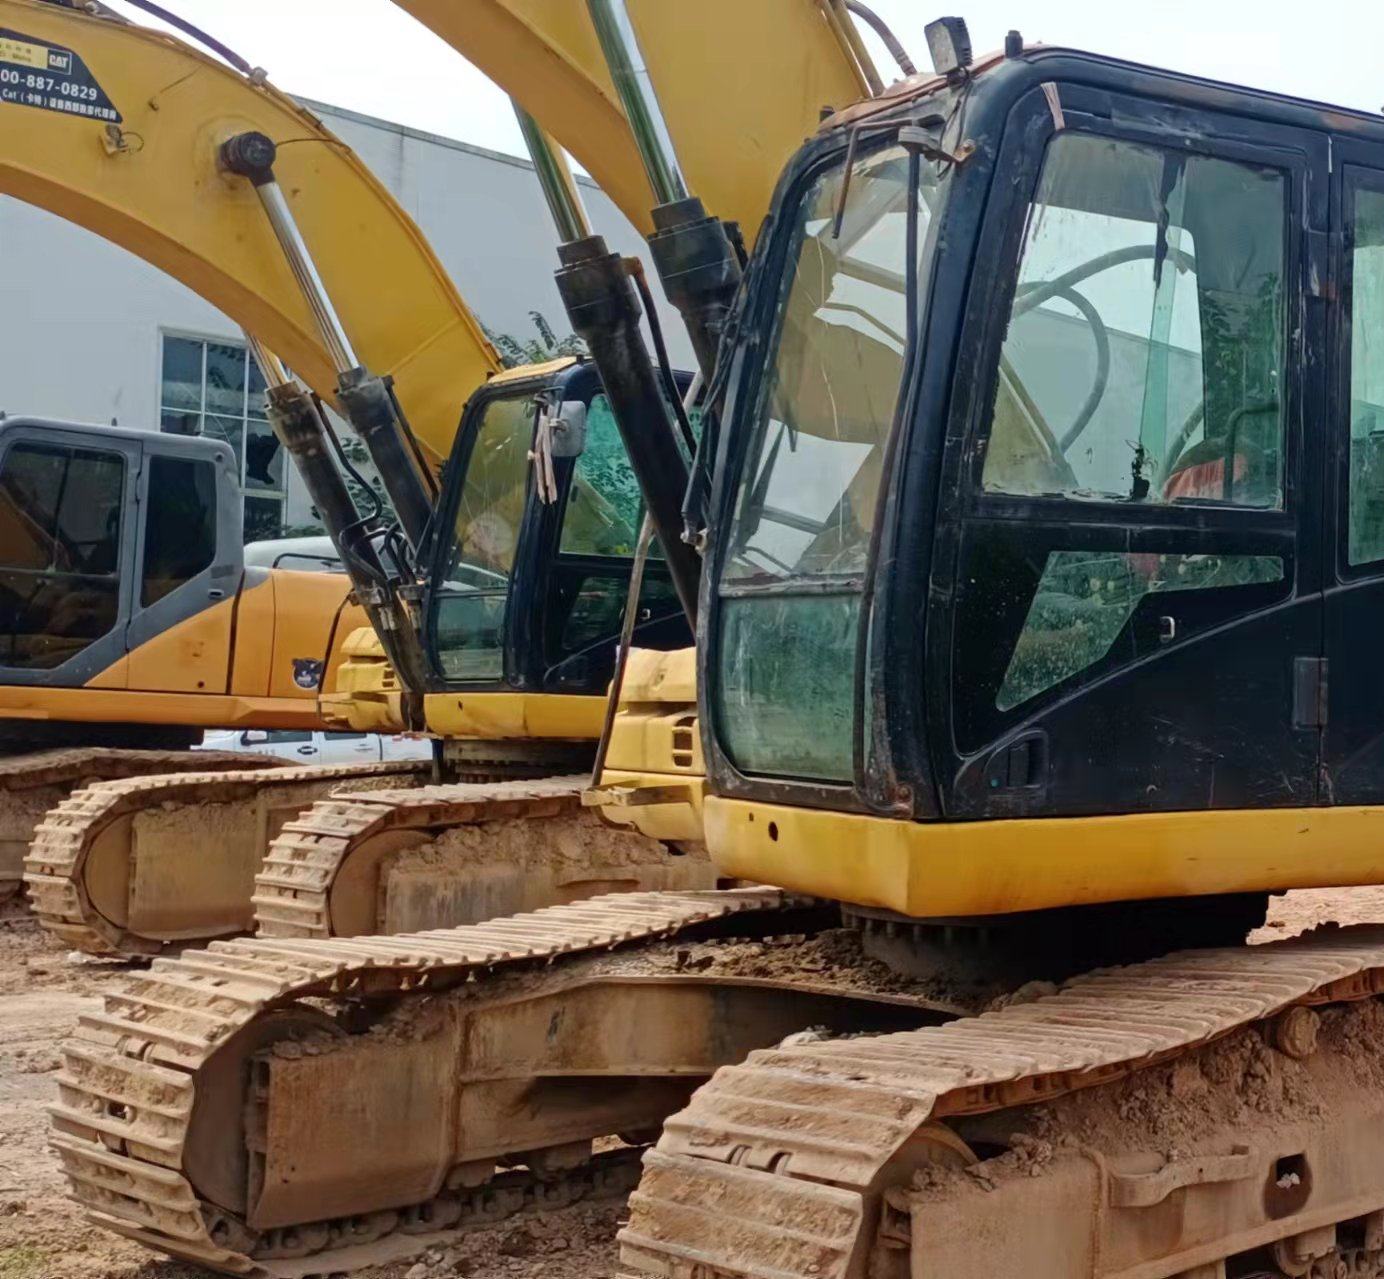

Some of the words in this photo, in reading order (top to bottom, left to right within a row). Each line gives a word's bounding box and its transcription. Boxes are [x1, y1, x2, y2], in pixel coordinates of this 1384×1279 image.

[49, 54, 68, 68] CAT
[0, 69, 97, 100] 00-887-0829
[2, 88, 17, 99] Cat
